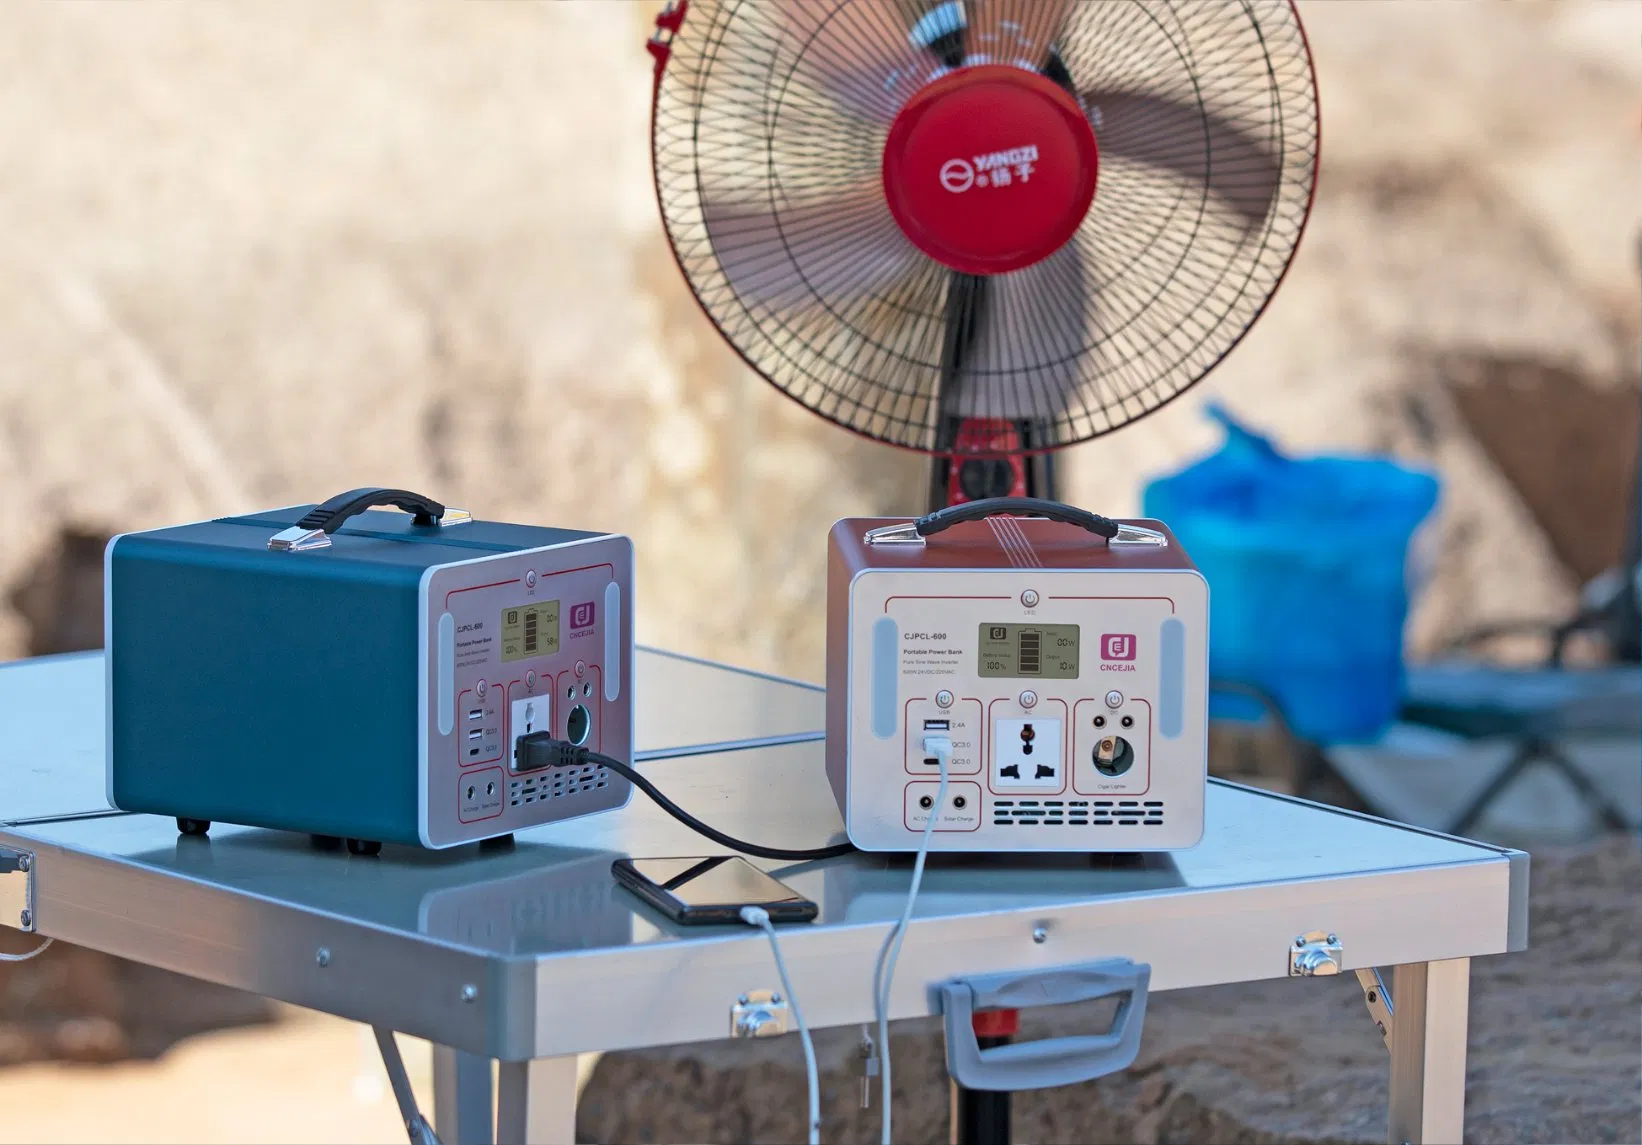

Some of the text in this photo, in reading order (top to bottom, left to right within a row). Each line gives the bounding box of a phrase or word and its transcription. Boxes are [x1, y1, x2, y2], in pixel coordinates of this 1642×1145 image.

[973, 144, 1039, 172] YANGZI
[569, 628, 594, 640] CNCEJIA
[904, 632, 947, 640] CJPCL-600
[1100, 664, 1136, 672] CNCEJIA
